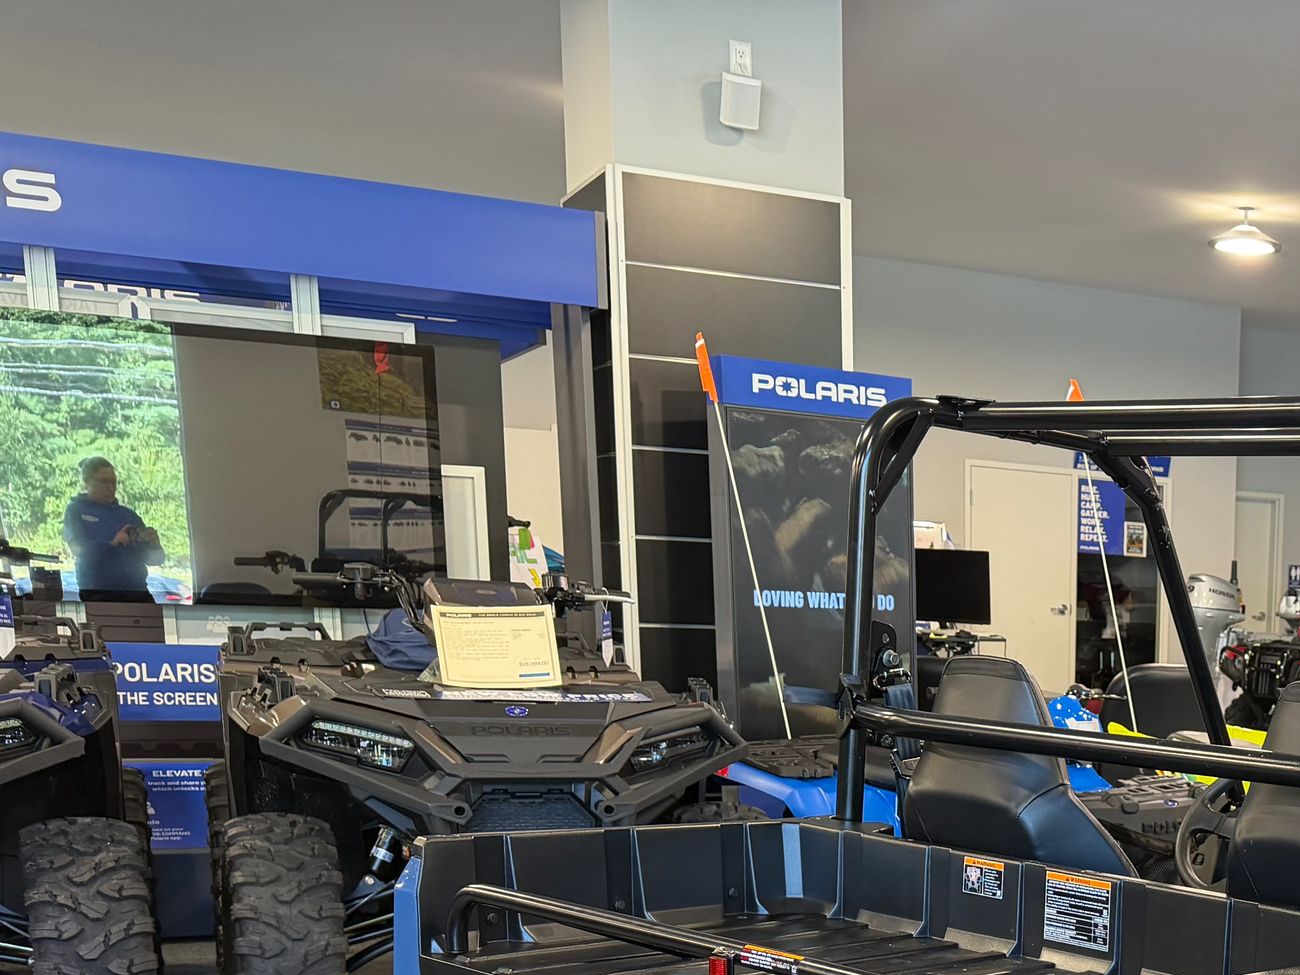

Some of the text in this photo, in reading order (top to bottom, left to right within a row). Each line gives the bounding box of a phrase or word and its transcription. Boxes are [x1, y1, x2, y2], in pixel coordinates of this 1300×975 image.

[752, 373, 888, 408] POLARIS
[1208, 587, 1236, 599] HONDA
[753, 589, 895, 611] LOVING WHAT DO
[117, 691, 218, 706] THE SCREEN
[471, 725, 570, 737] POLARIS
[152, 769, 202, 778] ELEVATE
[1070, 877, 1091, 886] WARNING
